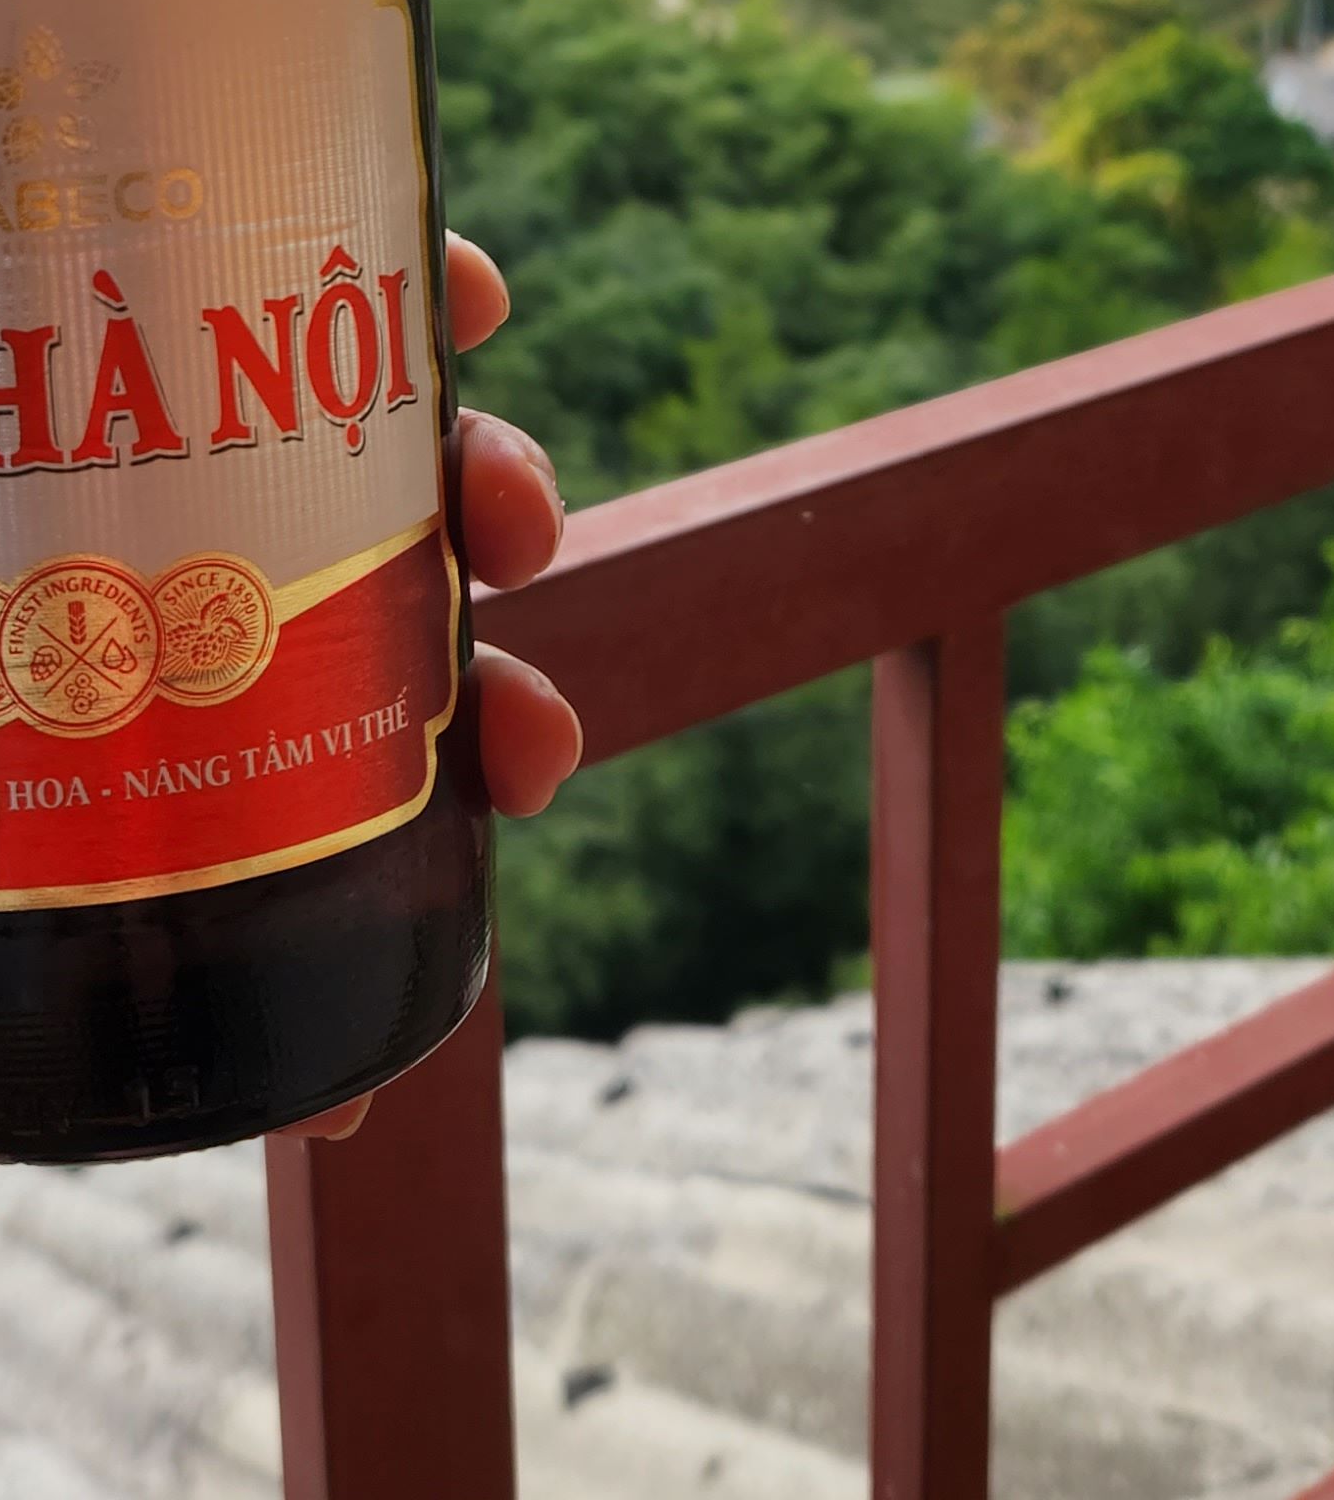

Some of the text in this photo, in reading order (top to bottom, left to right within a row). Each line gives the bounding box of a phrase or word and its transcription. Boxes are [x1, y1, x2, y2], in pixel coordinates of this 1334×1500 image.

[201, 244, 417, 455] NỘI
[9, 576, 151, 655] FINEST INGREDIENTS
[163, 572, 259, 614] SINCE 1890
[6, 776, 91, 810] HOA
[123, 759, 231, 800] NÂNG
[321, 722, 354, 759] VỊ
[359, 685, 409, 745] THẾ
